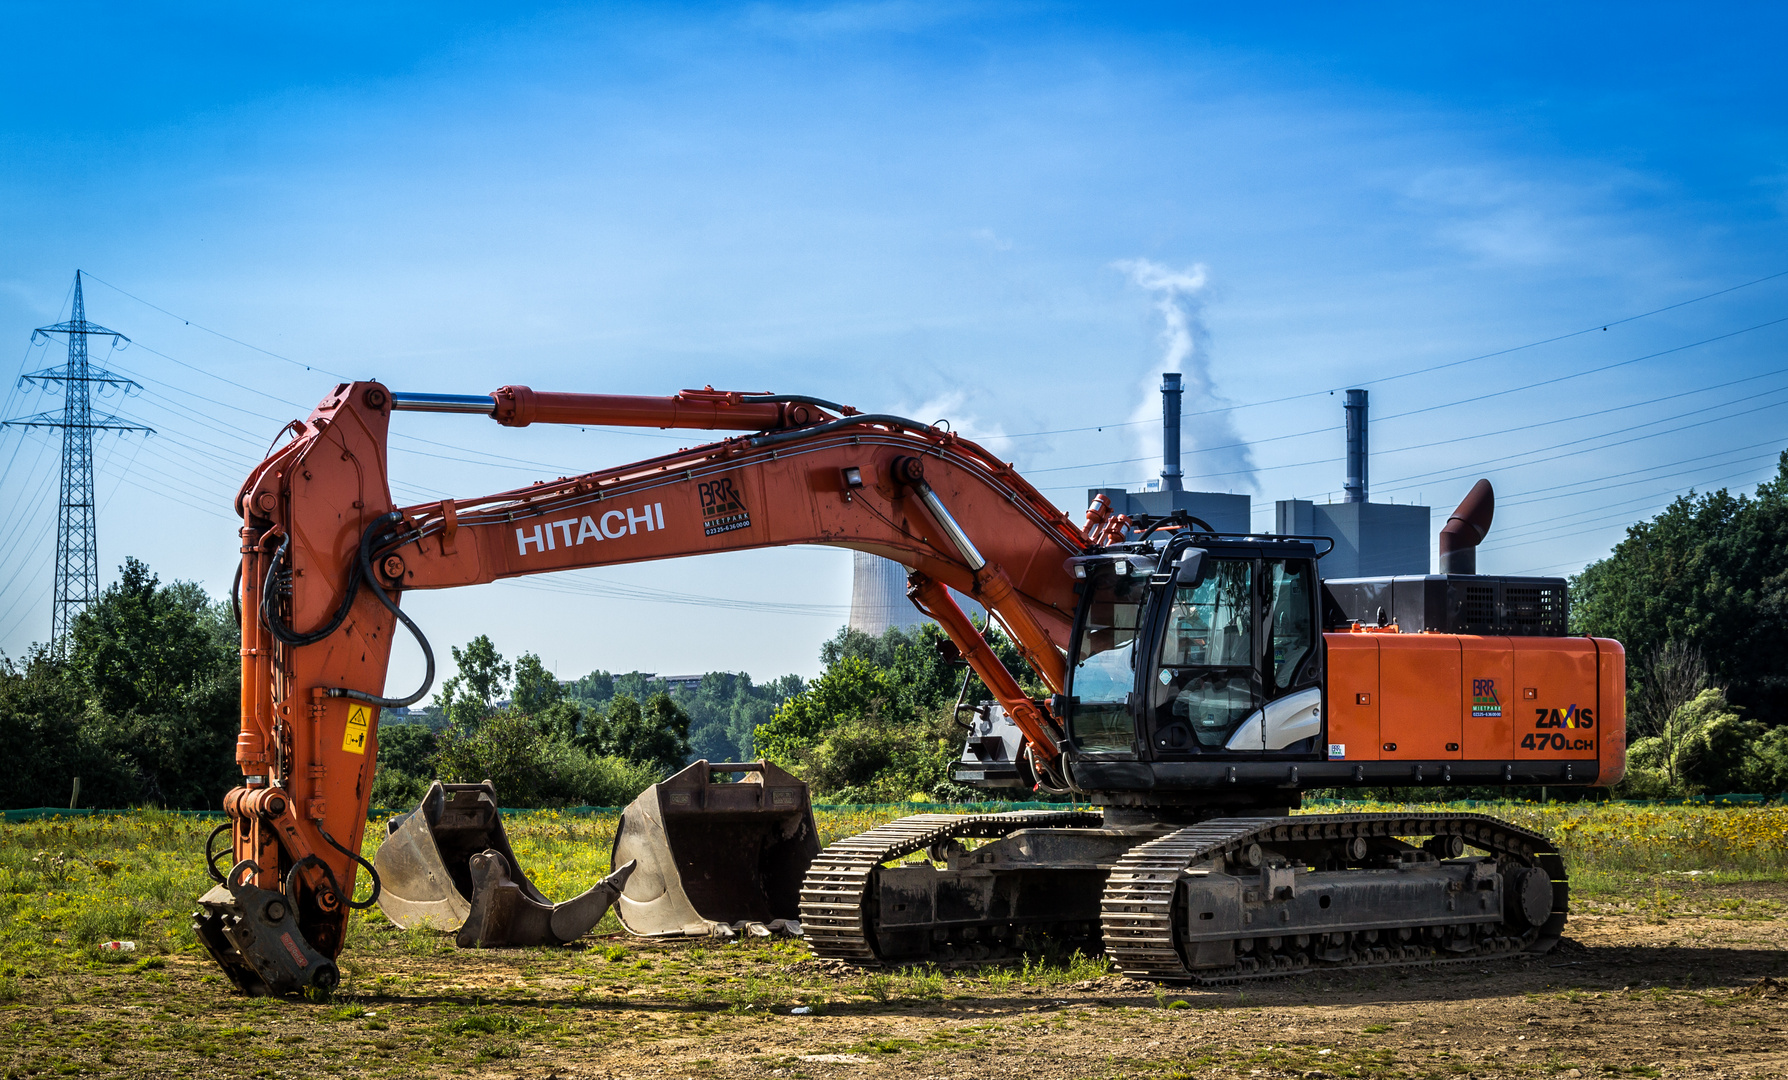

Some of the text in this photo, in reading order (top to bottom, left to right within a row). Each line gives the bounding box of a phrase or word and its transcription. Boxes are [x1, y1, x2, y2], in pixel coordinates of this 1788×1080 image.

[698, 478, 746, 511] BRR
[515, 502, 665, 556] HITACHI
[704, 512, 749, 528] MIETPARK
[1473, 679, 1500, 706] BRR
[1535, 704, 1594, 729] ZAXIS
[1520, 733, 1594, 751] 470LCH
